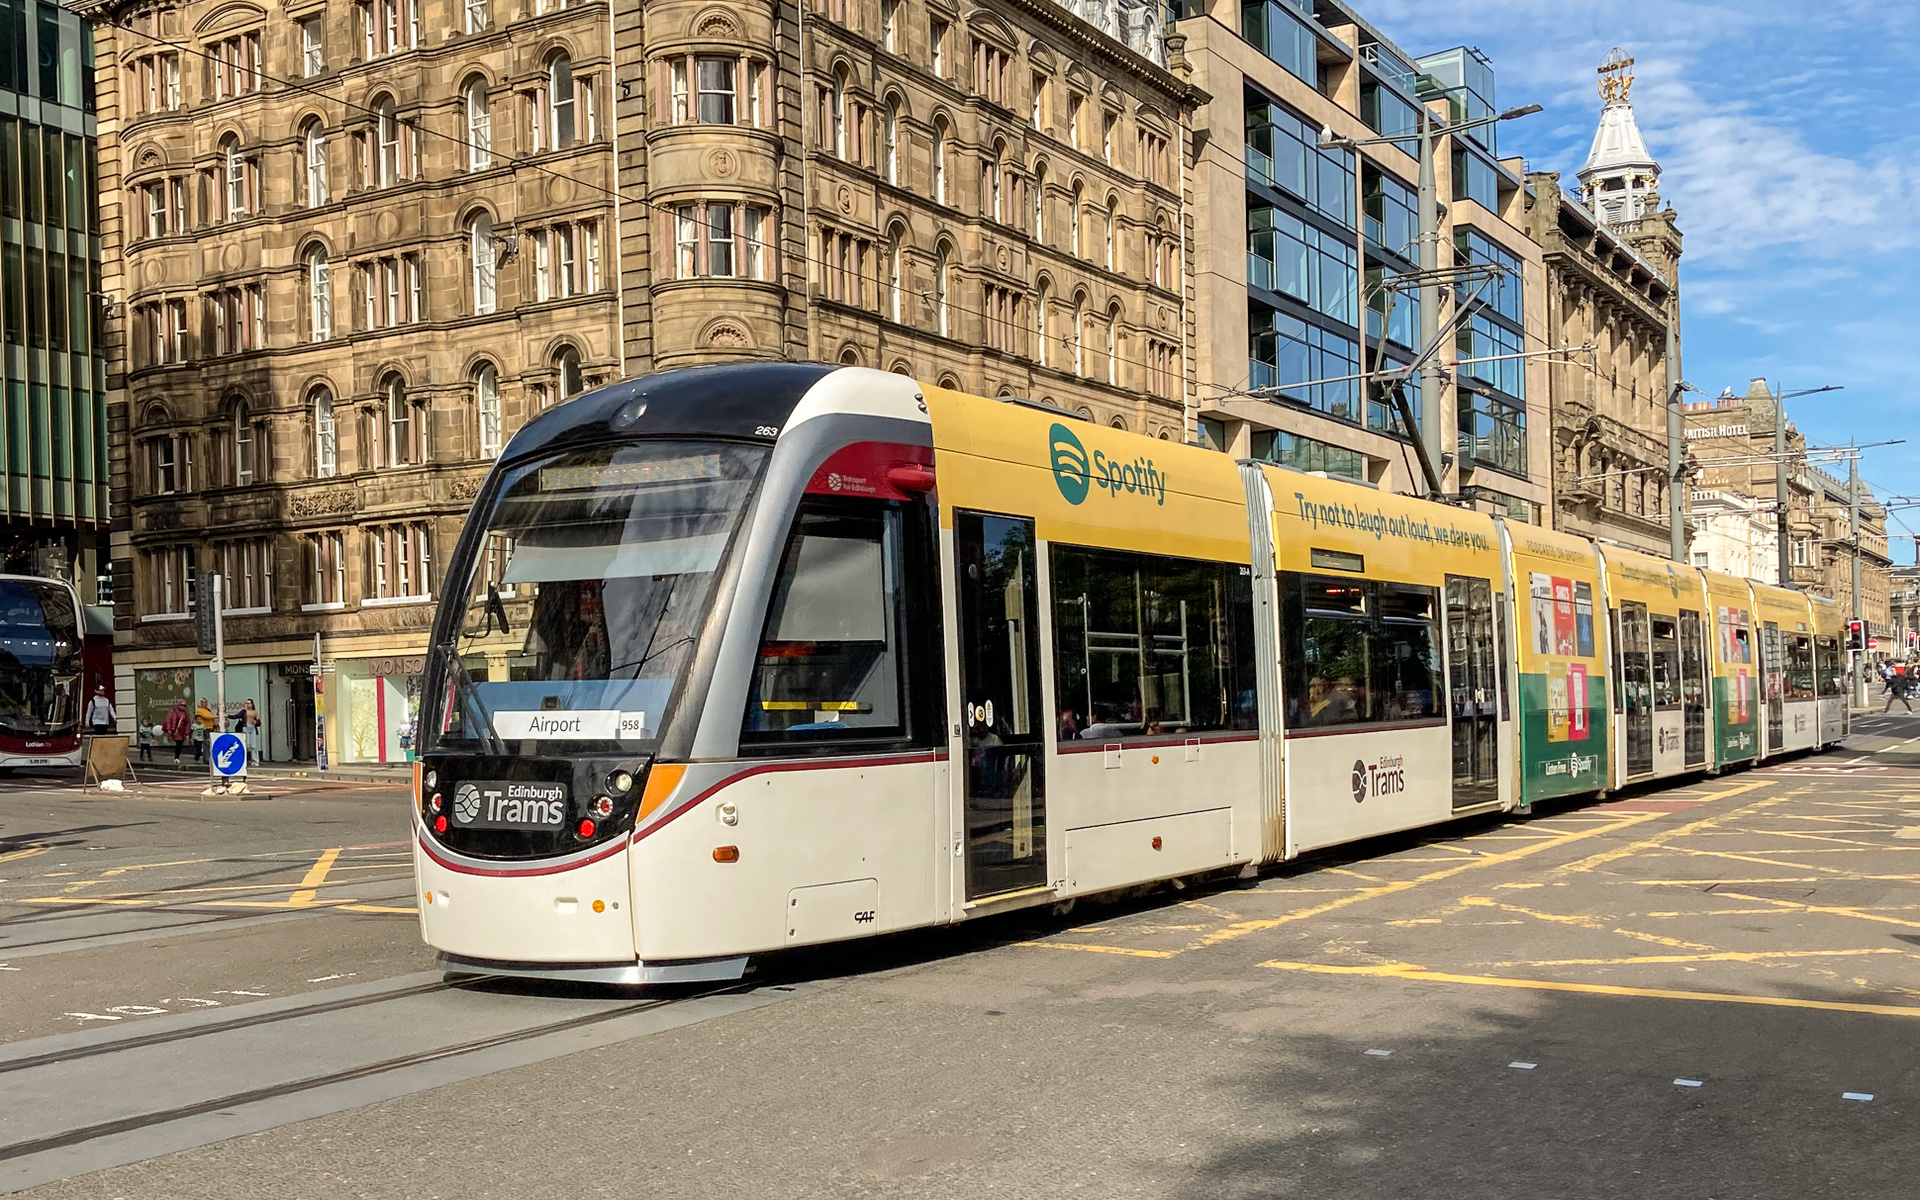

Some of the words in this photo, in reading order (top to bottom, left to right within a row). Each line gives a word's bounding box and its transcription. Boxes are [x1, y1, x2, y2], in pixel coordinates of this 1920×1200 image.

[754, 426, 778, 437] 263
[1719, 424, 1749, 437] HOTEL
[843, 475, 867, 484] Transport
[1093, 449, 1166, 506] Spotify
[852, 484, 877, 494] Edinburgh
[1294, 492, 1317, 530] Try
[1319, 502, 1340, 526] not
[1341, 504, 1355, 529] to
[1355, 503, 1387, 540] laugh
[1389, 515, 1406, 536] out
[1407, 514, 1434, 547] loud,
[1434, 525, 1449, 545] we
[1449, 523, 1470, 547] dare
[1471, 532, 1490, 555] you.
[211, 701, 246, 710] MSOON
[528, 716, 581, 735] Airport
[621, 720, 640, 731] 958
[1380, 754, 1403, 770] Edinburgh
[1368, 764, 1405, 797] Trams
[507, 785, 563, 801] Edinburgh
[484, 791, 564, 824] Trams
[854, 910, 875, 924] CAF
